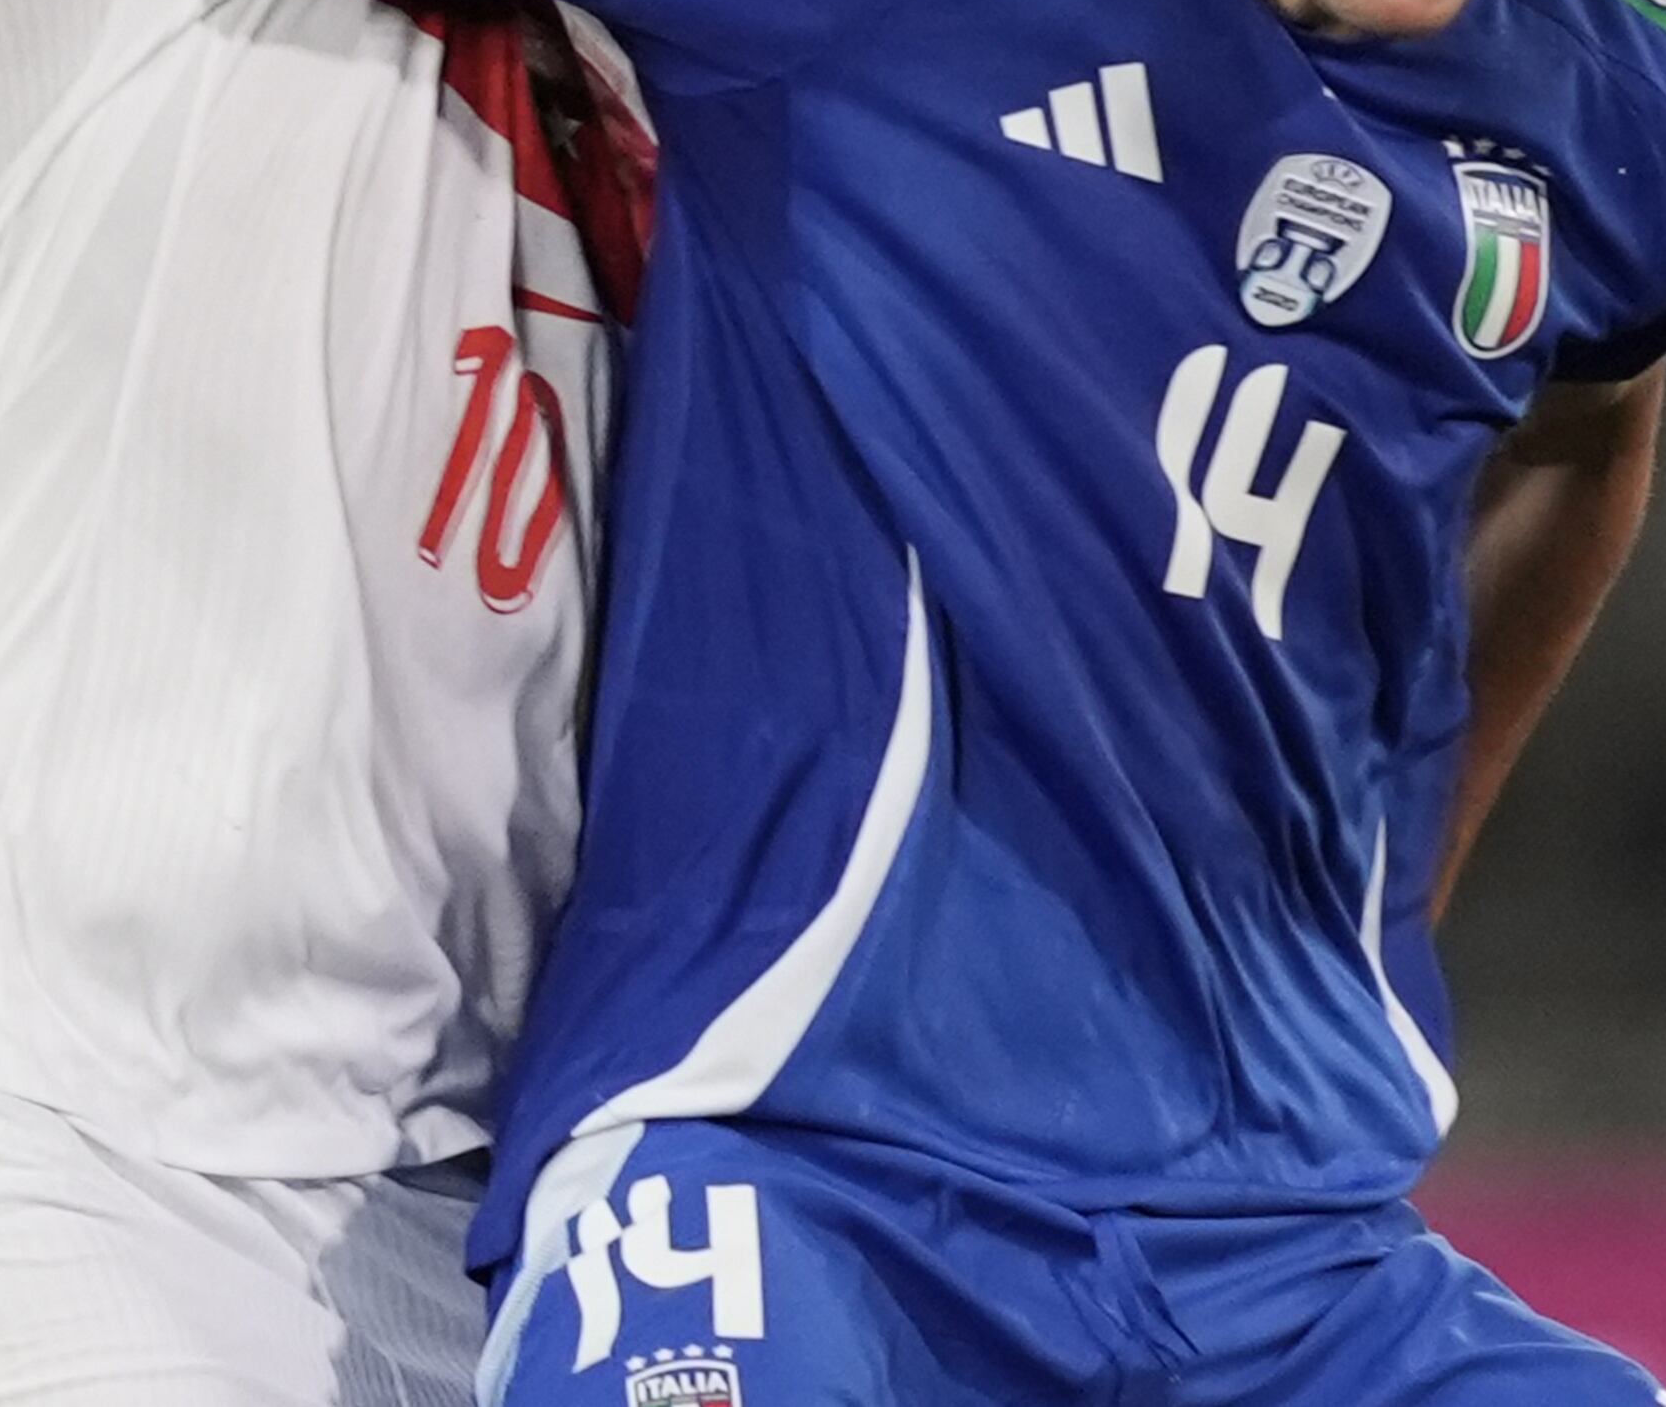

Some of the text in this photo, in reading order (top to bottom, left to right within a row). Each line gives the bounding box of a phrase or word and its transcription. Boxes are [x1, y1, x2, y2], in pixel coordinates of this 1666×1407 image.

[1465, 177, 1542, 225] ITALIA
[418, 325, 565, 614] 10
[1156, 344, 1348, 641] 14
[567, 1174, 764, 1374] 14
[636, 1371, 729, 1403] ITALIA
